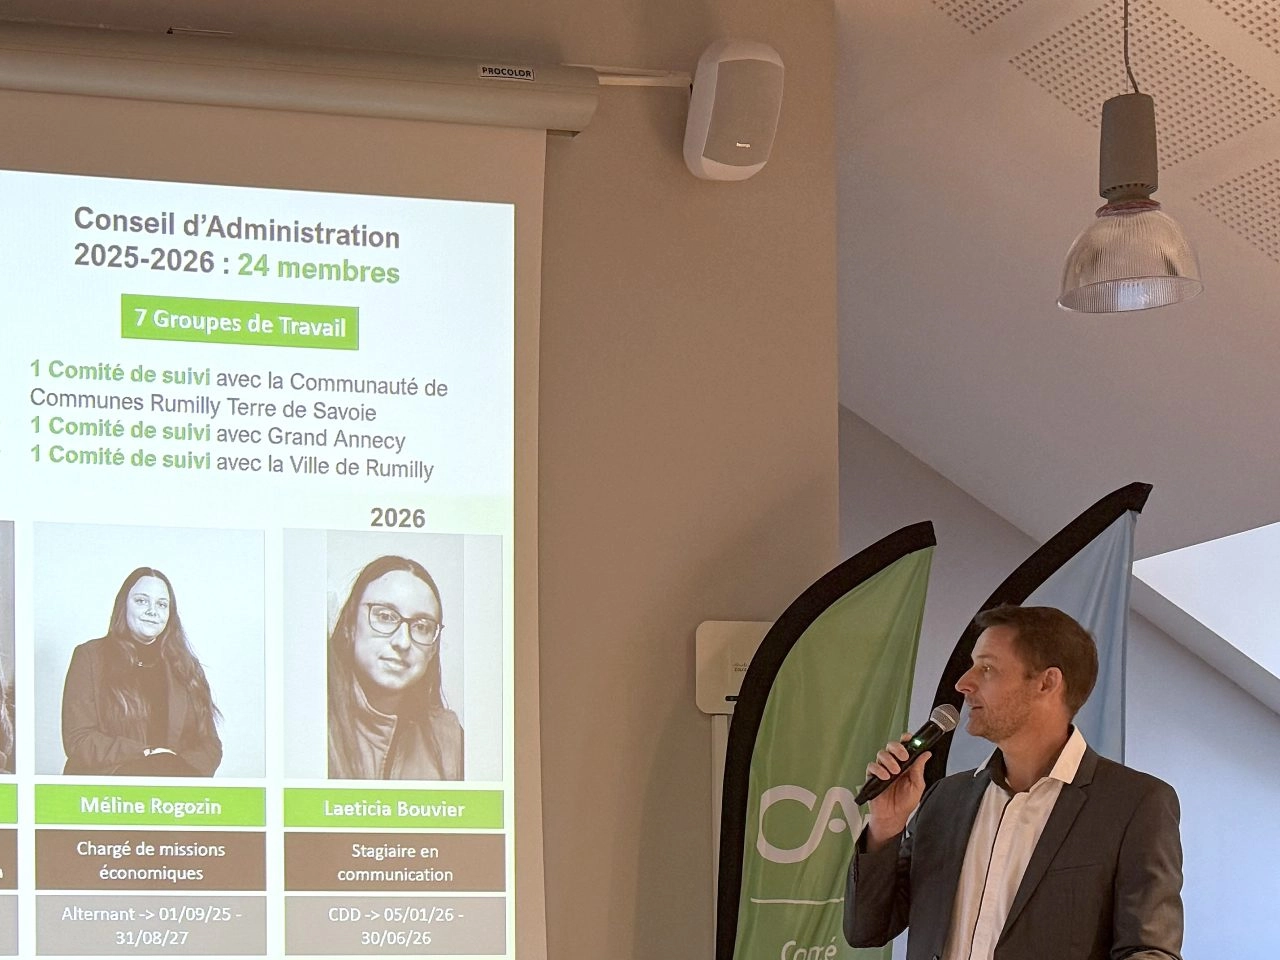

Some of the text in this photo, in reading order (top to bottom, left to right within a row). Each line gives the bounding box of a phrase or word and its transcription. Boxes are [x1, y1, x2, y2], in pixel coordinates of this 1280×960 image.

[482, 66, 532, 77] PROCOLOR
[74, 206, 401, 249] Conseil d’Administration
[74, 242, 215, 273] 2025-2026
[237, 252, 270, 277] 24
[277, 258, 400, 284] membres
[134, 308, 346, 337] 7 Groupes de Travail
[30, 359, 449, 397] 1 Comité de suivi avec la Communauté de
[30, 387, 377, 423] Communes Rumilly Terre de Savoie
[30, 416, 406, 453] 1 Comité de suivi avec Grand Annecy
[30, 444, 434, 484] 1 Comité de suivi avec la Ville de Rumilly
[370, 507, 426, 529] 2026
[80, 797, 222, 820] Méline Rogozin
[323, 800, 465, 818] Laeticia Bouvier
[756, 784, 870, 864] CA
[76, 841, 226, 861] Chargé de missions
[351, 843, 439, 862] Stagiaire en
[99, 864, 205, 885] économiques
[337, 867, 454, 883] communication
[61, 907, 136, 923] Alternant
[158, 906, 231, 925] 01/09/25
[328, 908, 361, 923] CDD
[383, 907, 455, 925] 05/01/26
[115, 929, 189, 948] 31/08/27
[361, 929, 432, 947] 30/06/26
